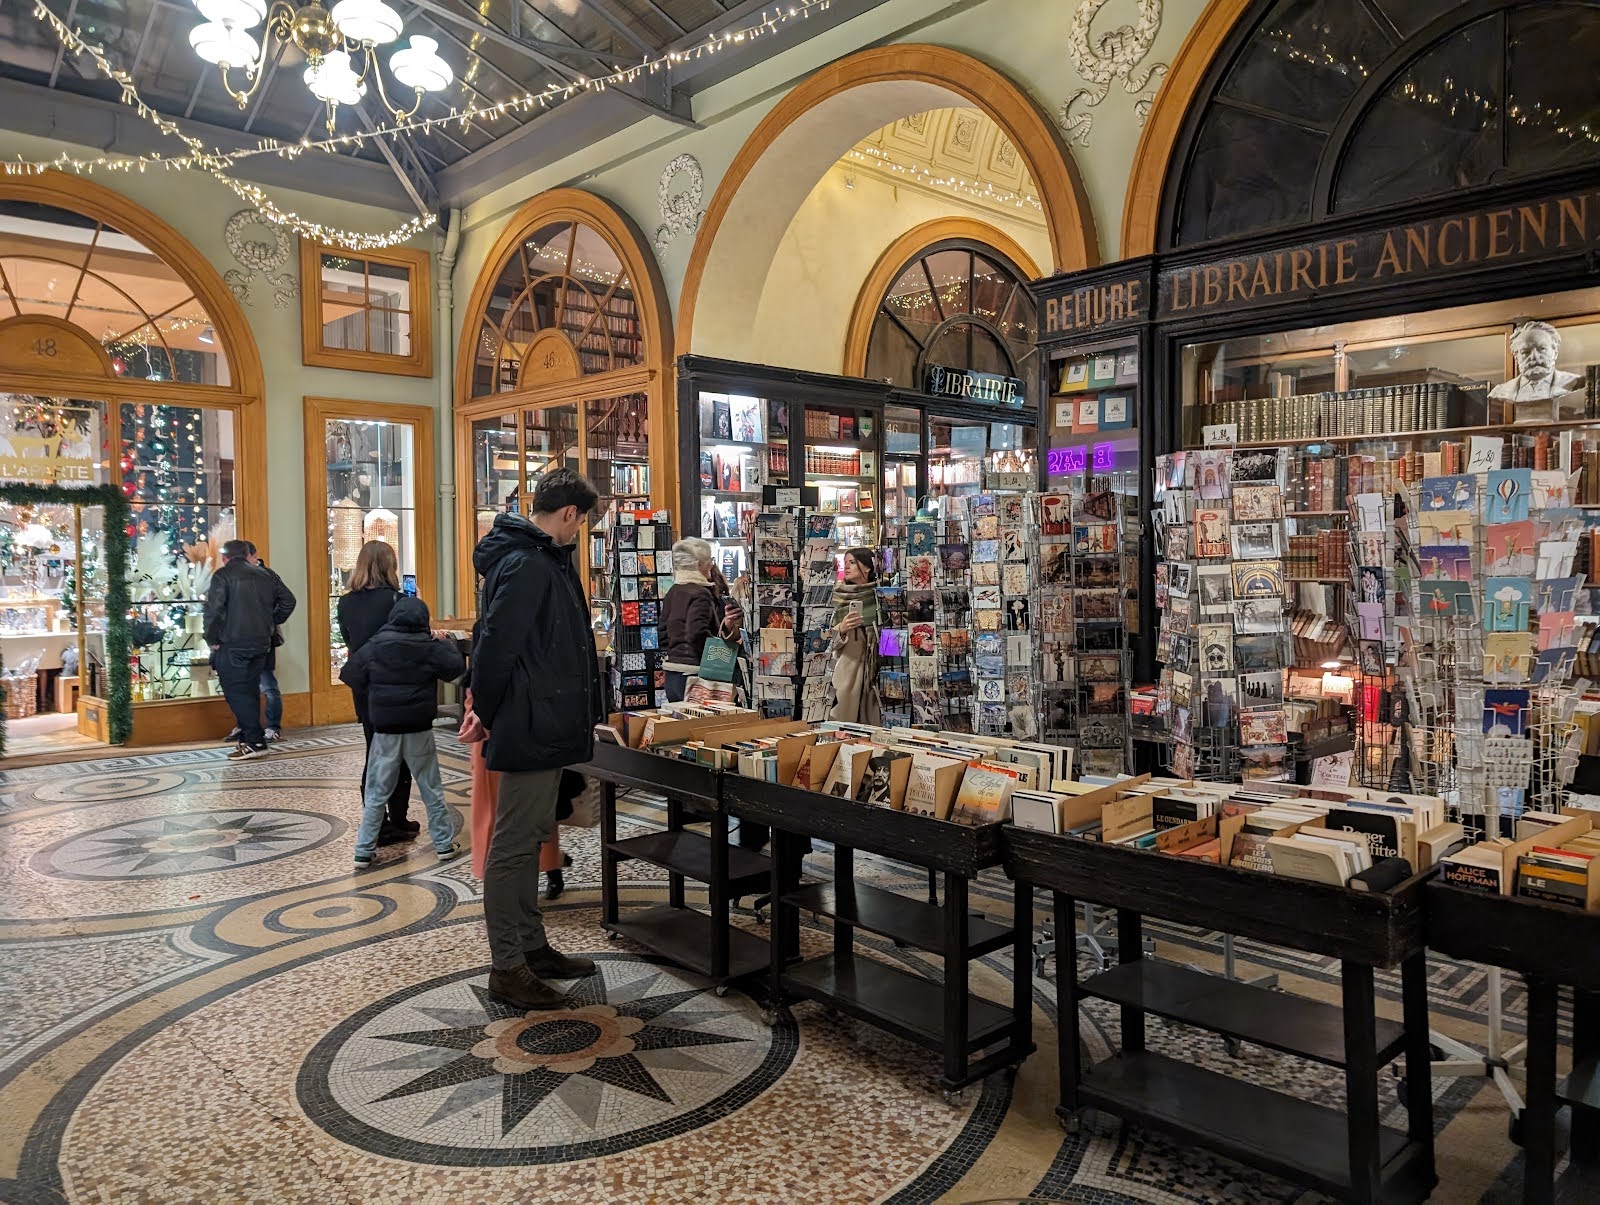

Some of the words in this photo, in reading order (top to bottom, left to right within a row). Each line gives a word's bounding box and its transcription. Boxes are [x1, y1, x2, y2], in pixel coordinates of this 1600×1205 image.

[1171, 238, 1358, 311] LIBRAIRIE
[1373, 193, 1600, 279] ANCIENN
[1045, 279, 1141, 333] RELIURE
[34, 337, 57, 357] 48
[544, 351, 555, 369] 46
[931, 365, 1017, 404] LIBRAIRIE
[885, 422, 899, 436] 46
[1010, 754, 1018, 764] Le
[1156, 814, 1194, 826] LEGENDAR
[1342, 825, 1386, 844] Rger
[1446, 871, 1497, 887] HOFFMAN
[1456, 866, 1486, 878] ALICE
[1527, 877, 1546, 888] LE
